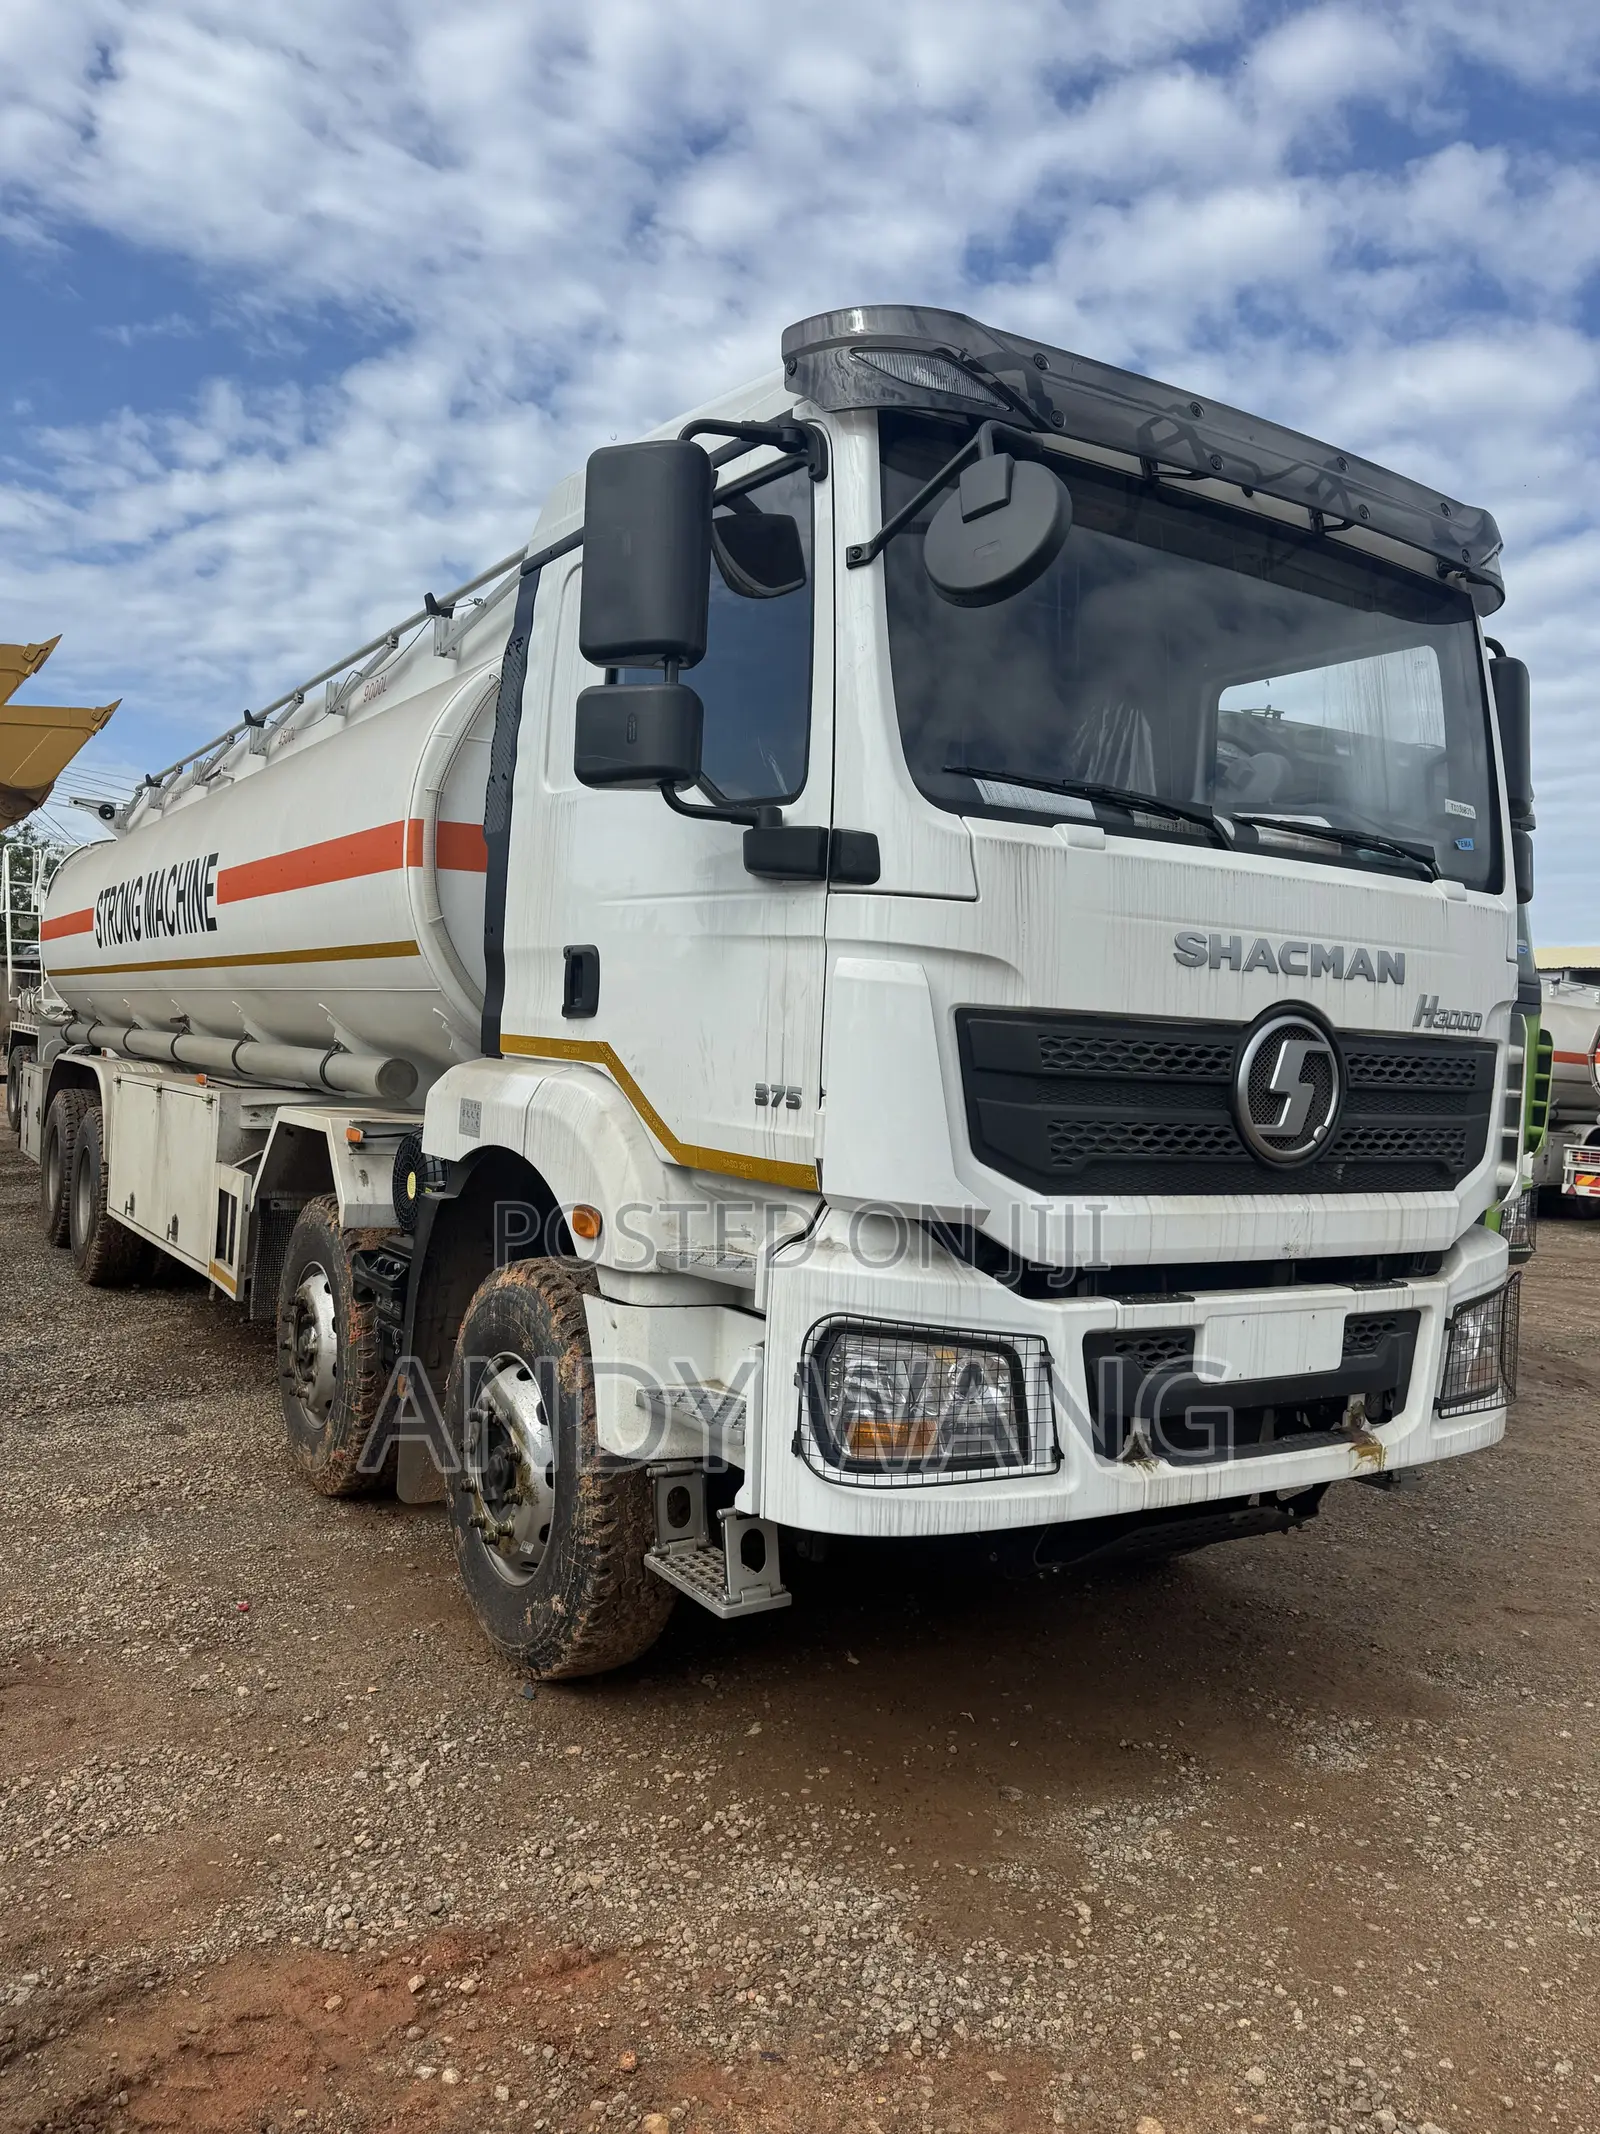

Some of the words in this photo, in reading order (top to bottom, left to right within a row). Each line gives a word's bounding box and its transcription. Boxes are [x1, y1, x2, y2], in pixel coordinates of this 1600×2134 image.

[363, 676, 387, 702] 9000L
[95, 875, 143, 949] STRONG
[144, 852, 219, 939] MACHINE
[1173, 931, 1406, 985] SHACMAN
[1412, 994, 1483, 1032] H3000
[754, 1082, 803, 1110] 375
